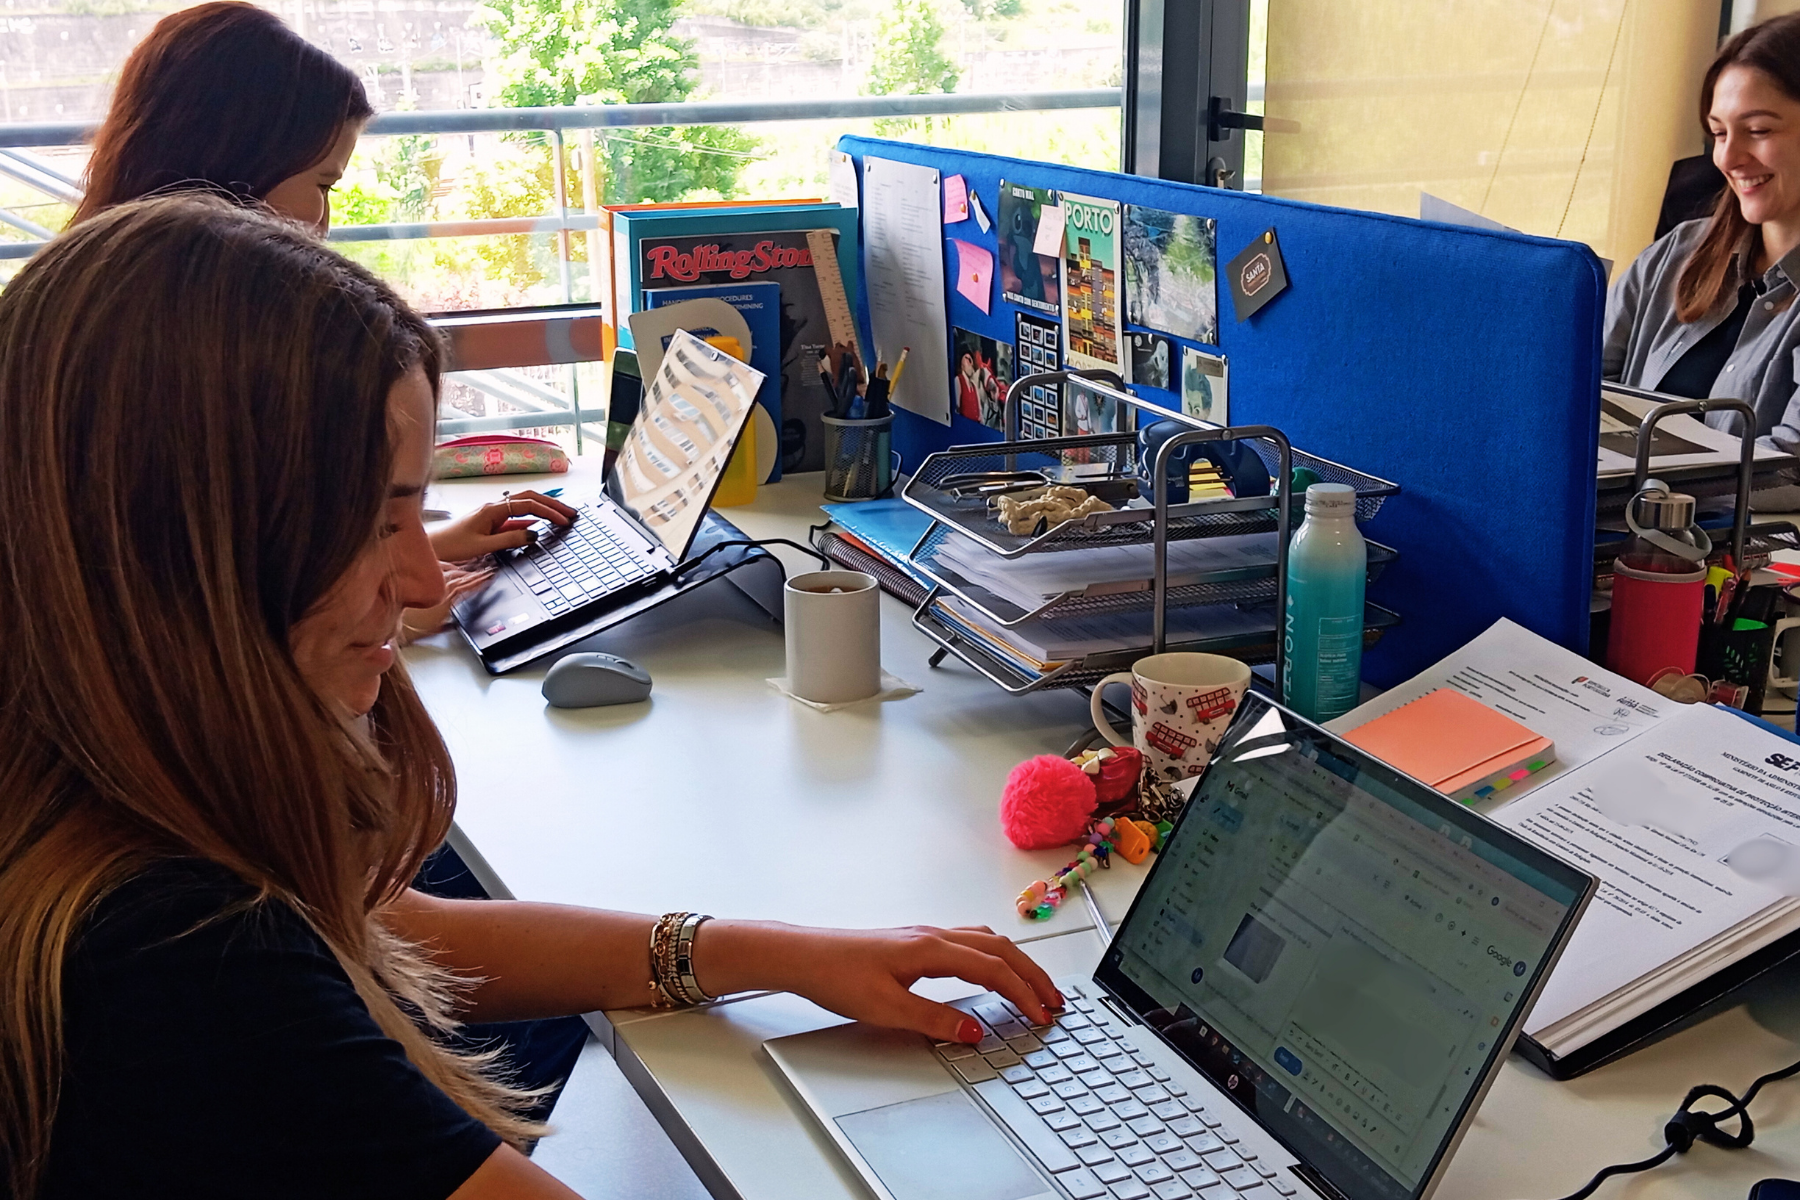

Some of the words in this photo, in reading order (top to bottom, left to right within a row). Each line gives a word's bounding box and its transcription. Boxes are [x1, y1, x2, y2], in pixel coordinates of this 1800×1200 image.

[1065, 202, 1113, 234] PORTO
[647, 244, 752, 282] Rolling
[750, 241, 814, 272] Ston
[1246, 262, 1265, 283] SANTA
[1486, 945, 1512, 967] Google
